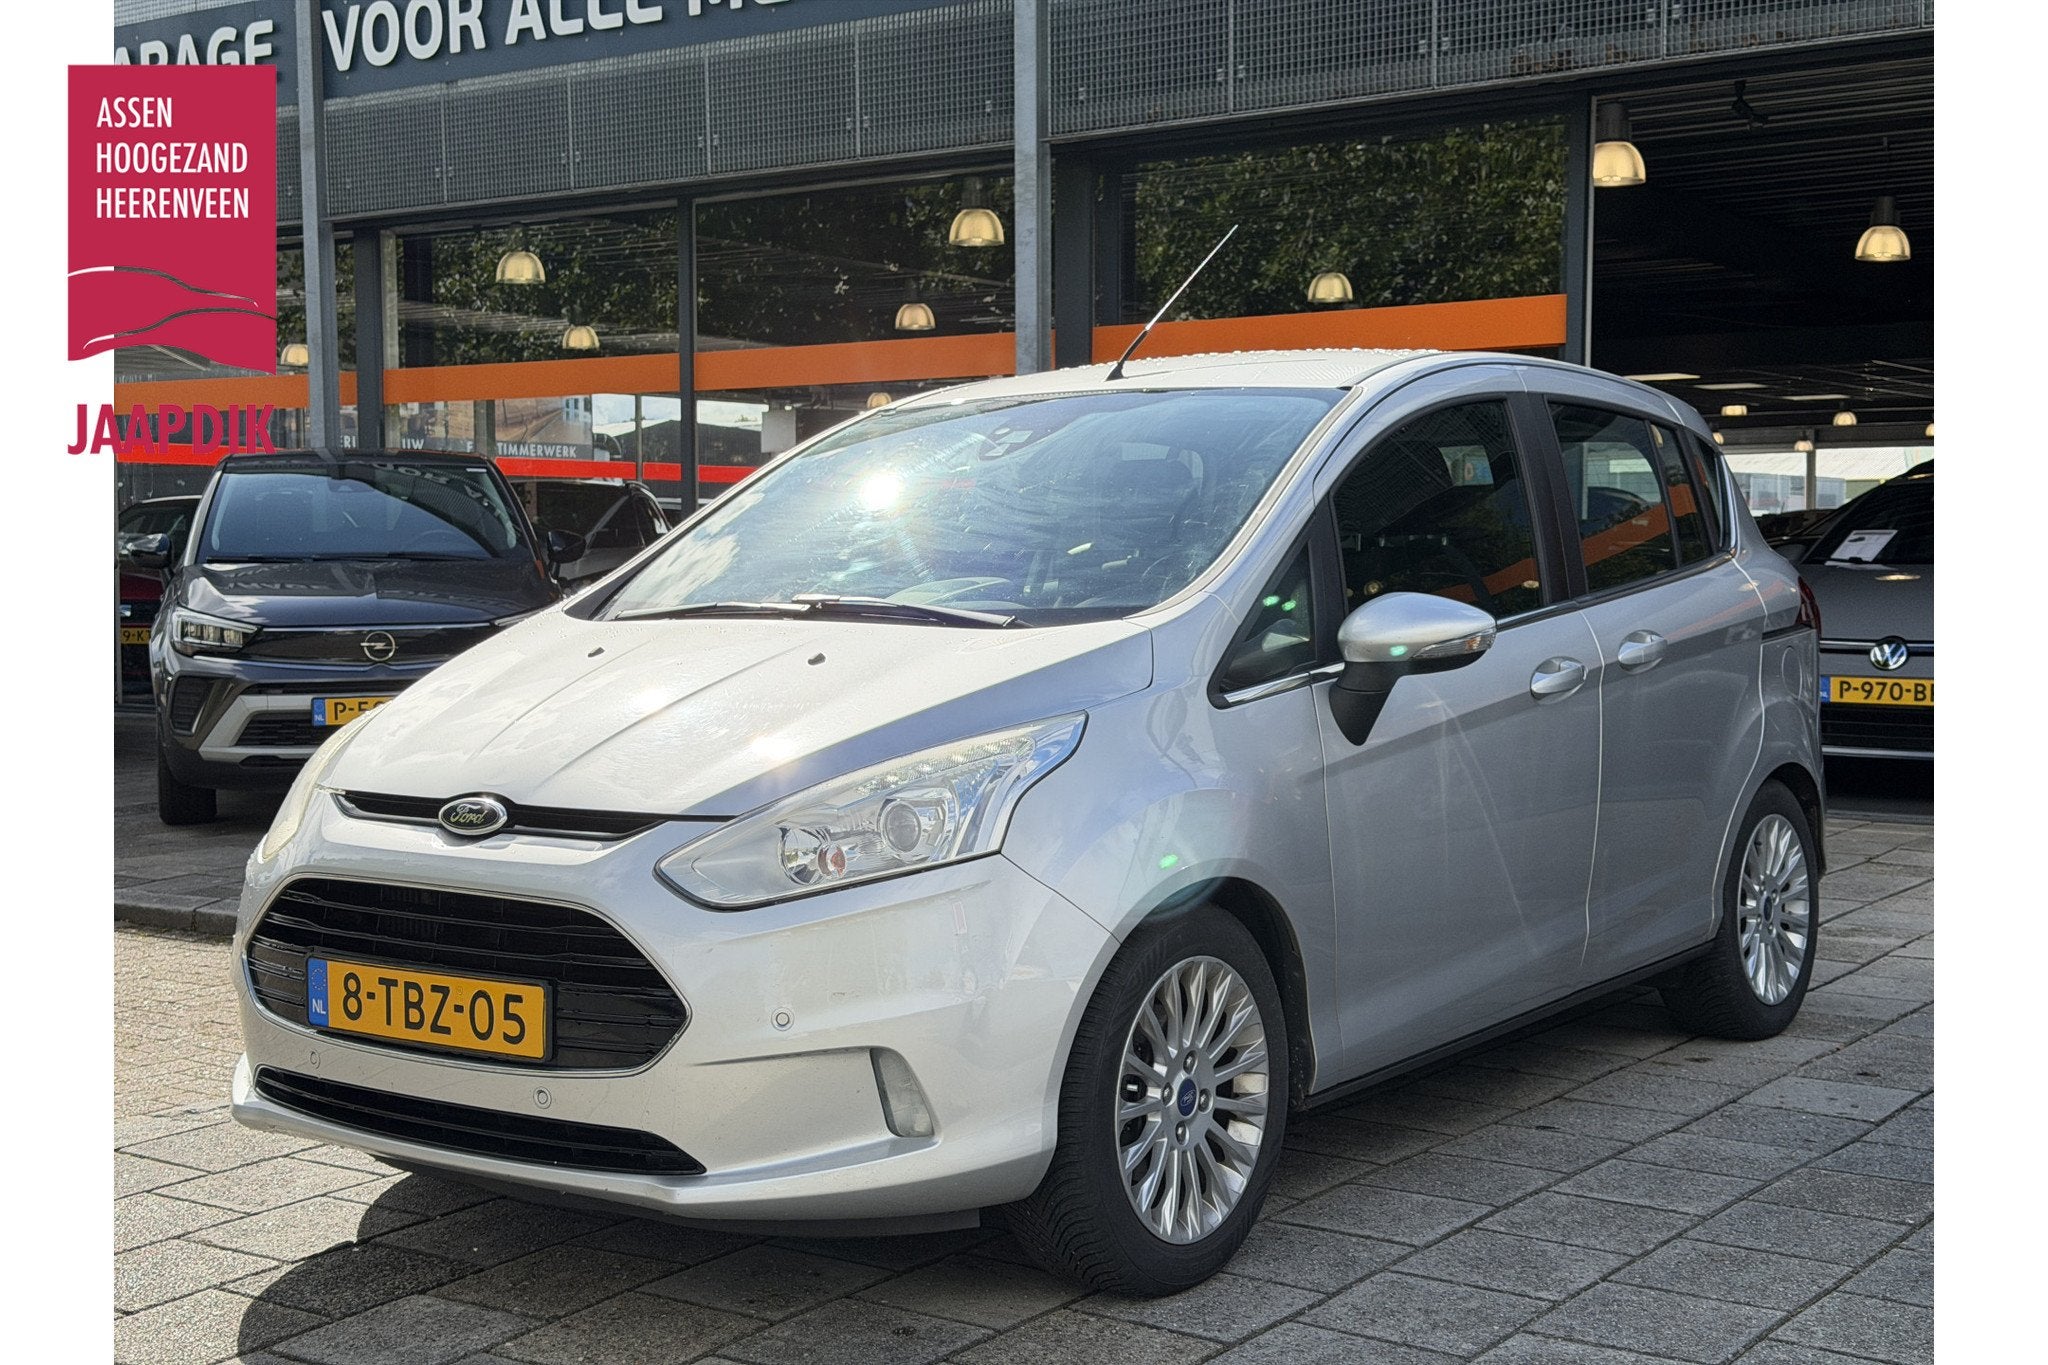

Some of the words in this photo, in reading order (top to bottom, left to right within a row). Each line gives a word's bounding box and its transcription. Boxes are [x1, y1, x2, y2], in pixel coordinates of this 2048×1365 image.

[322, 0, 486, 72] VOOR
[497, 442, 577, 459] TIMMERWERK
[1839, 680, 1934, 703] P-970-B
[450, 803, 489, 824] Ford
[312, 998, 327, 1015] NL
[342, 971, 526, 1046] 8-TBZ-05
